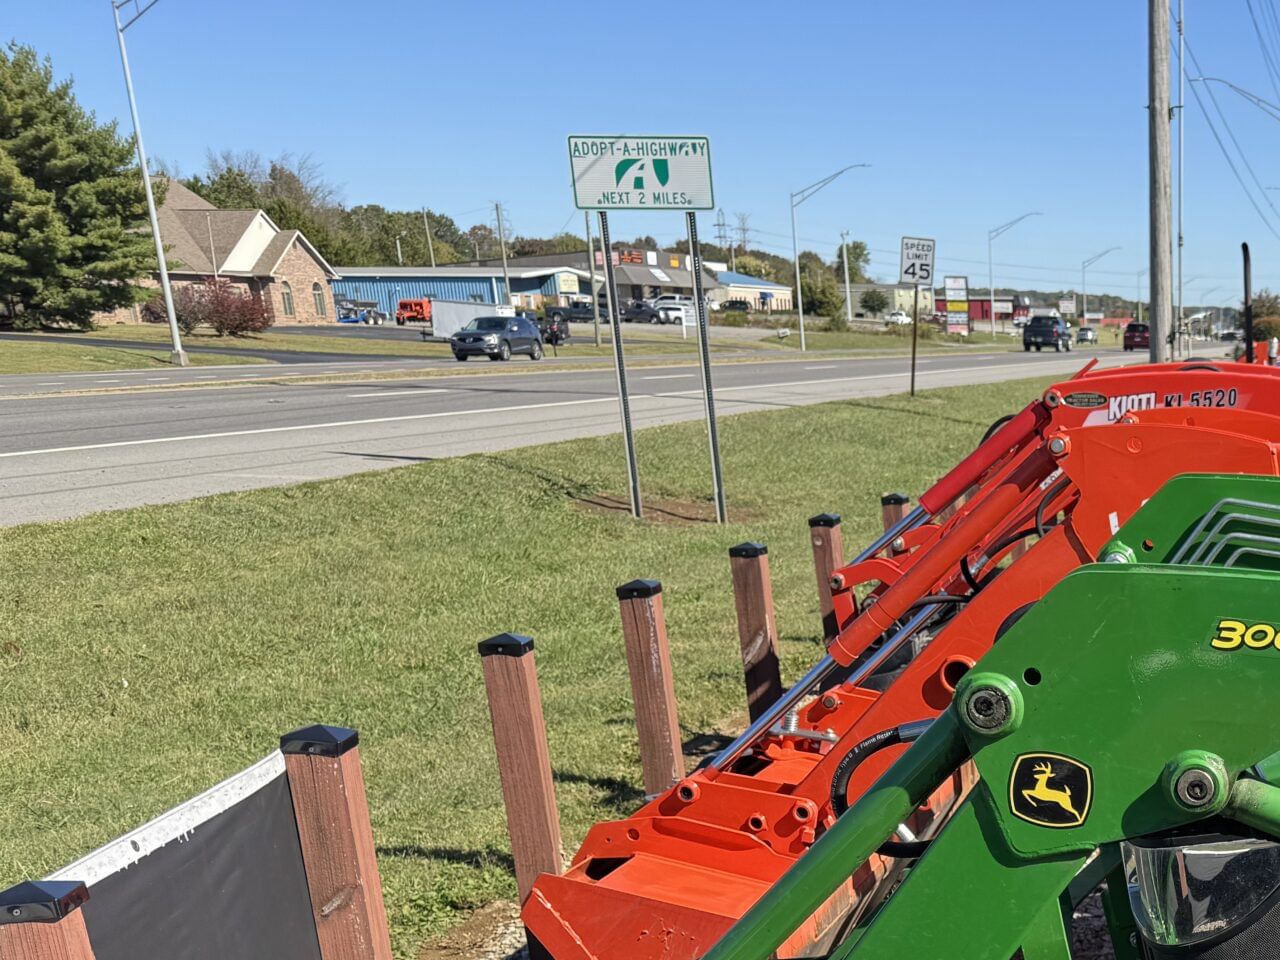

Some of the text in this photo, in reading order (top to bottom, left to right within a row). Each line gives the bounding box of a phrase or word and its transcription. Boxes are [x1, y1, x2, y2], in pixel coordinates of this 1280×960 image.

[573, 141, 705, 157] ADOPT-A-HIGHWAY
[602, 191, 687, 206] NEXT 2 MILES
[904, 242, 932, 253] SPEED
[906, 252, 929, 261] LIMIT
[904, 262, 930, 280] 45
[1108, 392, 1156, 421] KIOTI
[1190, 388, 1238, 408] 5520
